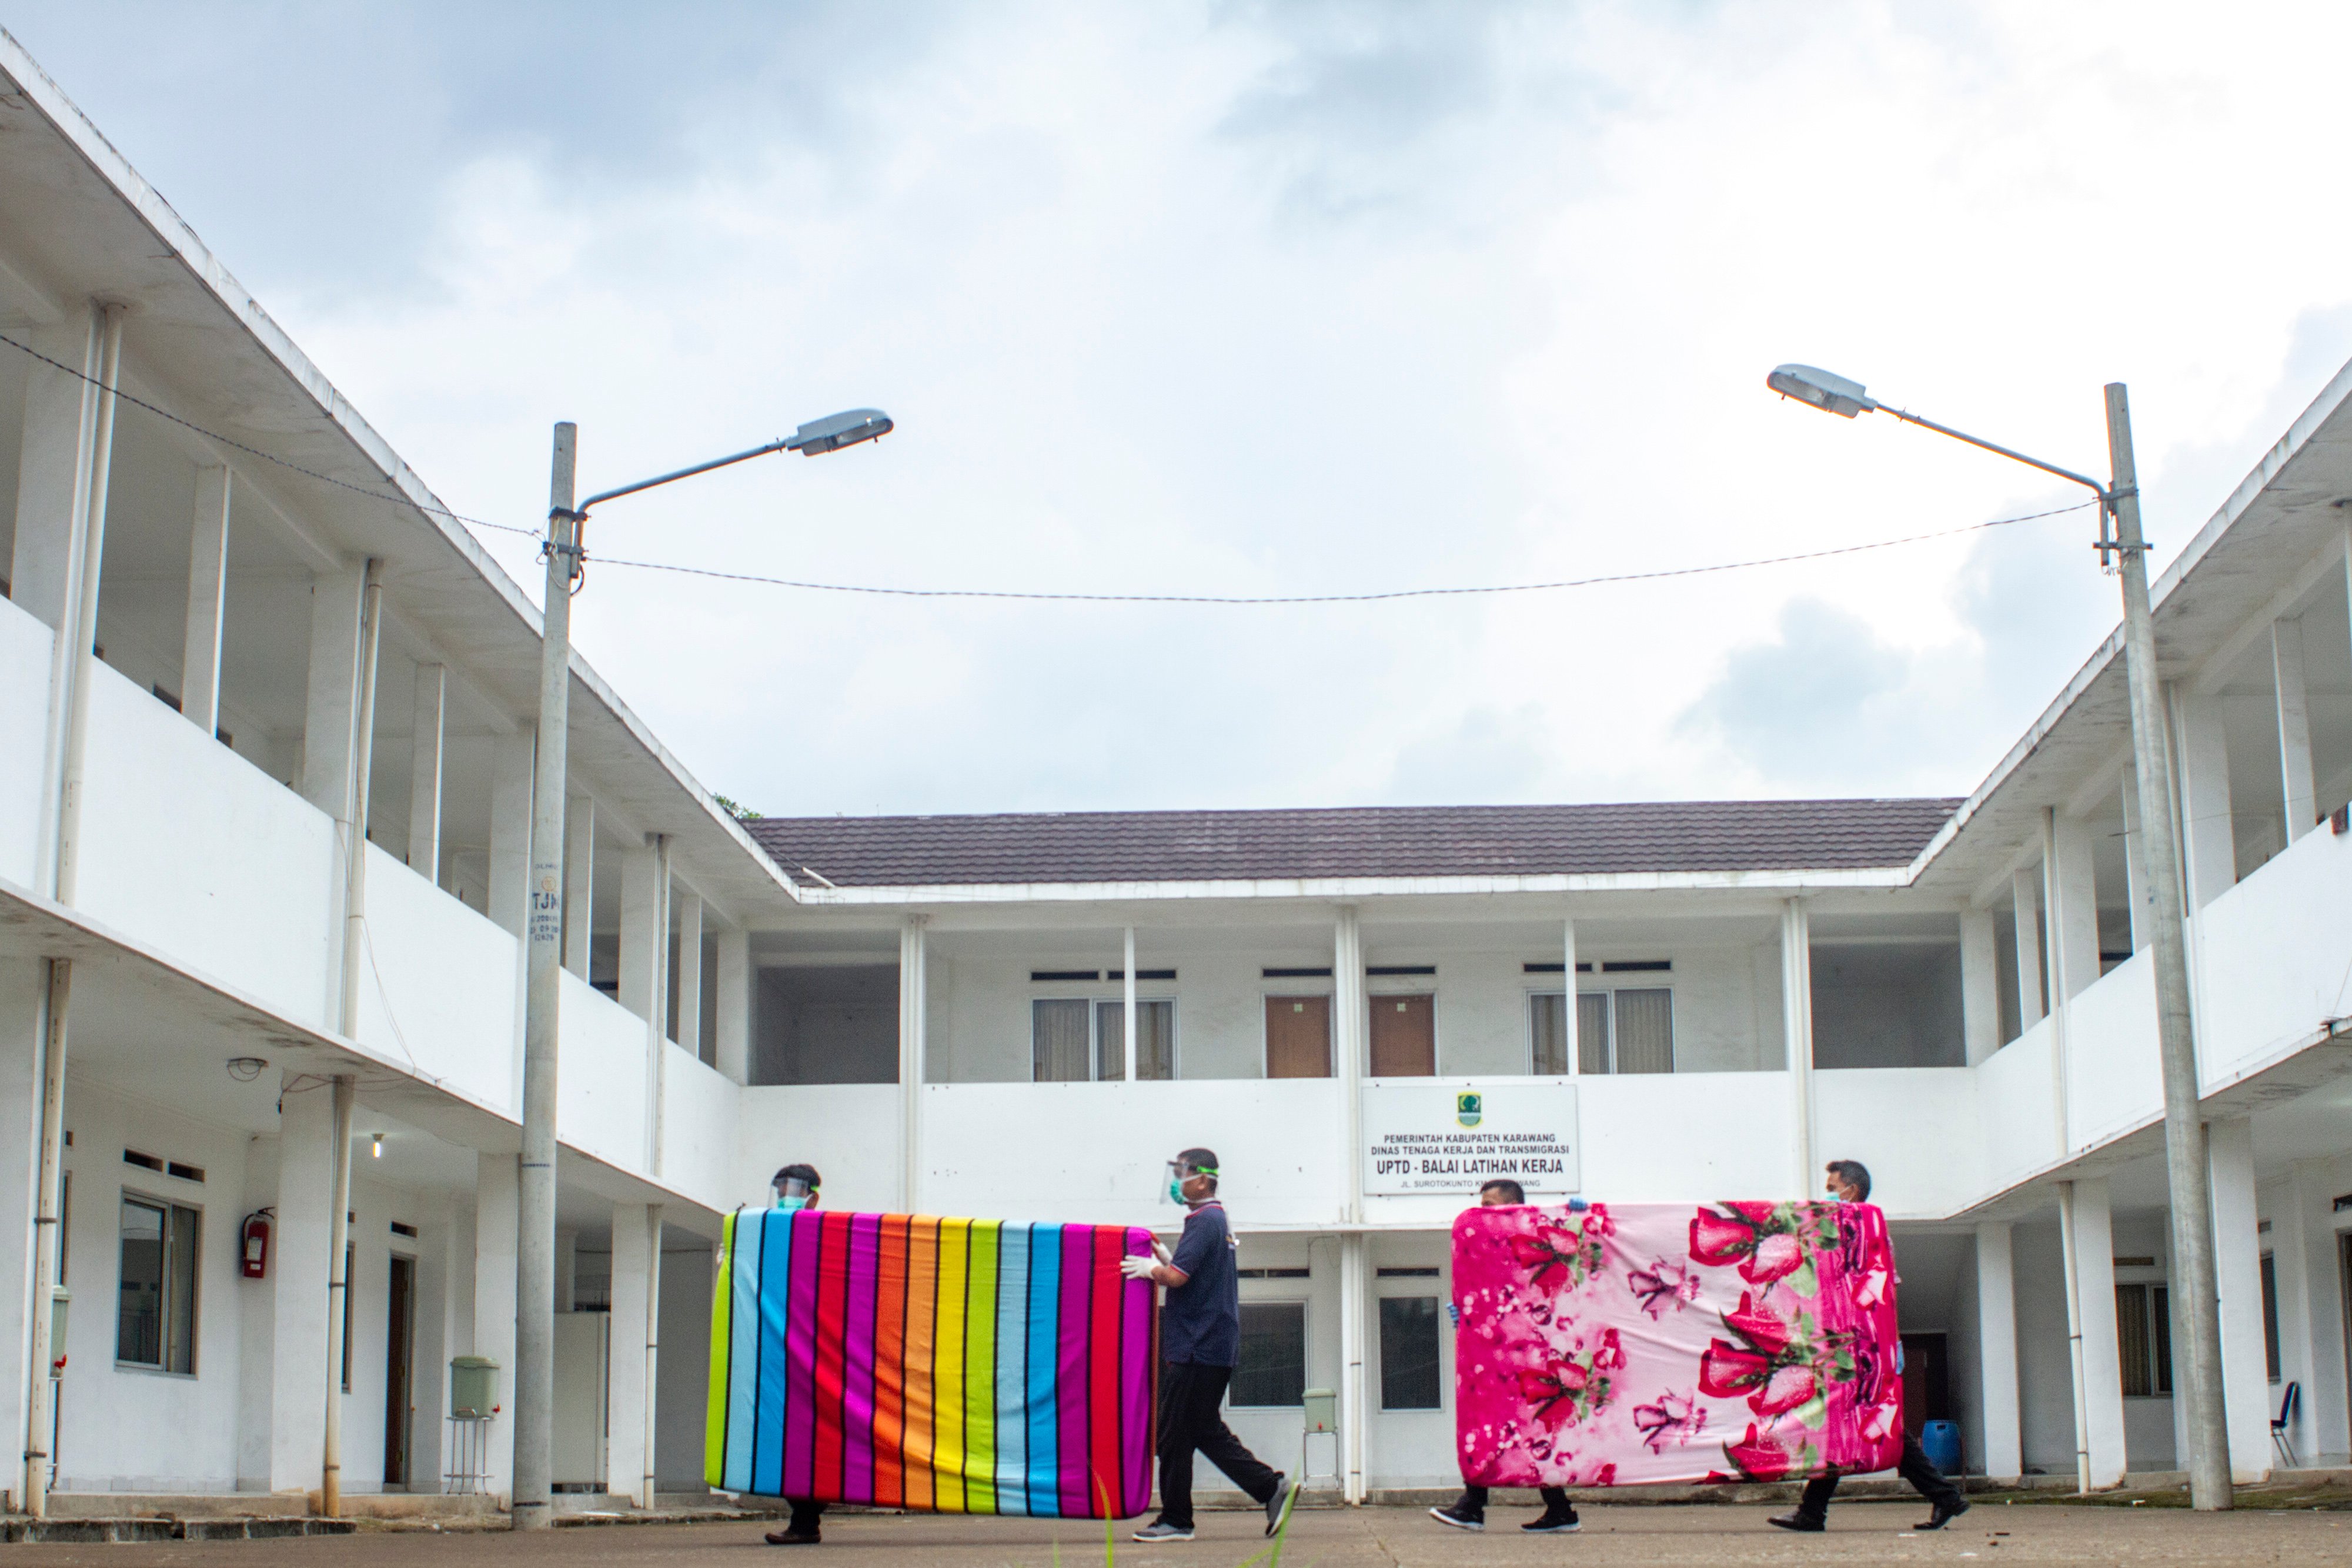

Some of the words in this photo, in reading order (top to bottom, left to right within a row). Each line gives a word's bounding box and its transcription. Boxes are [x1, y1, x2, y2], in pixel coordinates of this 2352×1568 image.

[1384, 1134, 1442, 1144] PEMERINTAH
[1446, 1134, 1499, 1143] KABUPATEN
[1503, 1134, 1556, 1142] KARAWANG
[1371, 1146, 1399, 1155] DINAS
[1402, 1146, 1440, 1155] TENAGA
[1443, 1145, 1474, 1154] KERJA
[1476, 1145, 1495, 1154] DAN
[1499, 1145, 1569, 1154] TRANSMIGRASI
[1377, 1160, 1410, 1174] UPTD
[1422, 1159, 1459, 1174] BALAI
[1463, 1159, 1517, 1174] LATIHAN
[1522, 1159, 1563, 1173] KERJA
